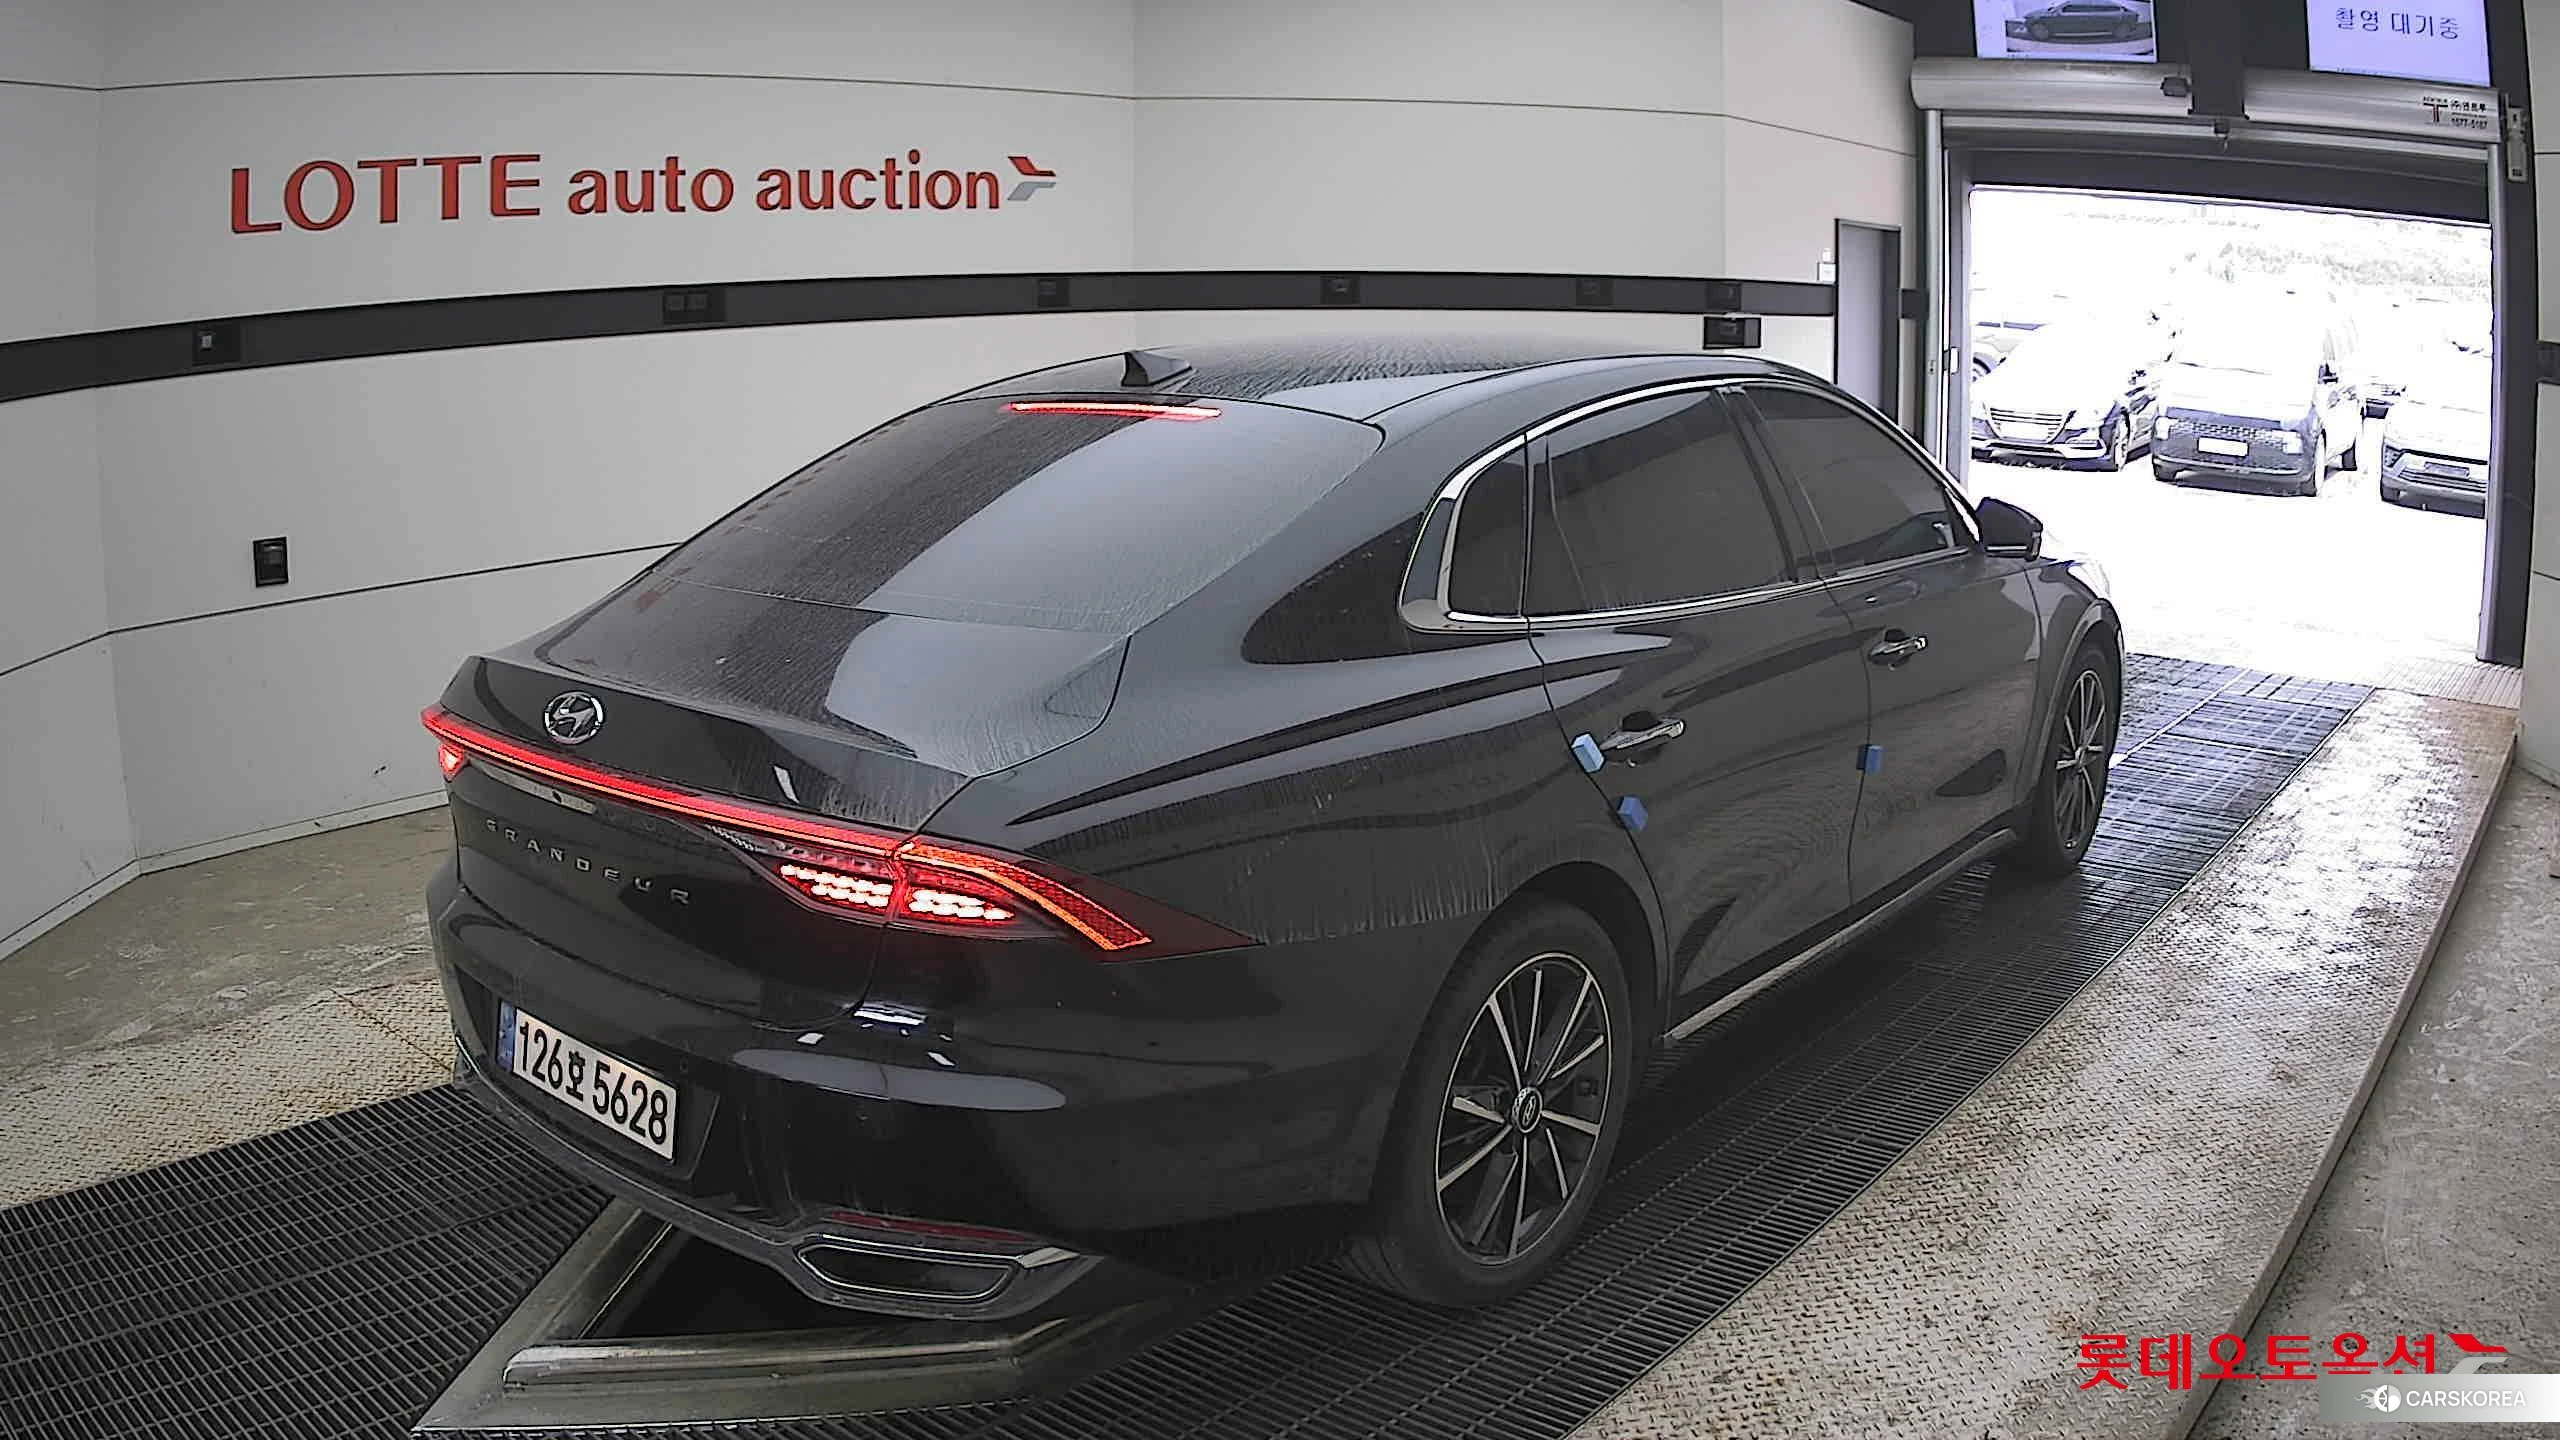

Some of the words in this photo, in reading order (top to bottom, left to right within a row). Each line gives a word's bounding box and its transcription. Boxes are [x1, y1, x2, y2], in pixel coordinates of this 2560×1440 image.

[2336, 7, 2379, 32] 촬영
[2391, 12, 2458, 40] 대기중
[231, 154, 540, 233] LOTTE
[567, 155, 735, 215] auto
[755, 148, 1002, 211] auction
[486, 818, 690, 905] GRANDEUR
[591, 1059, 669, 1146] 5628
